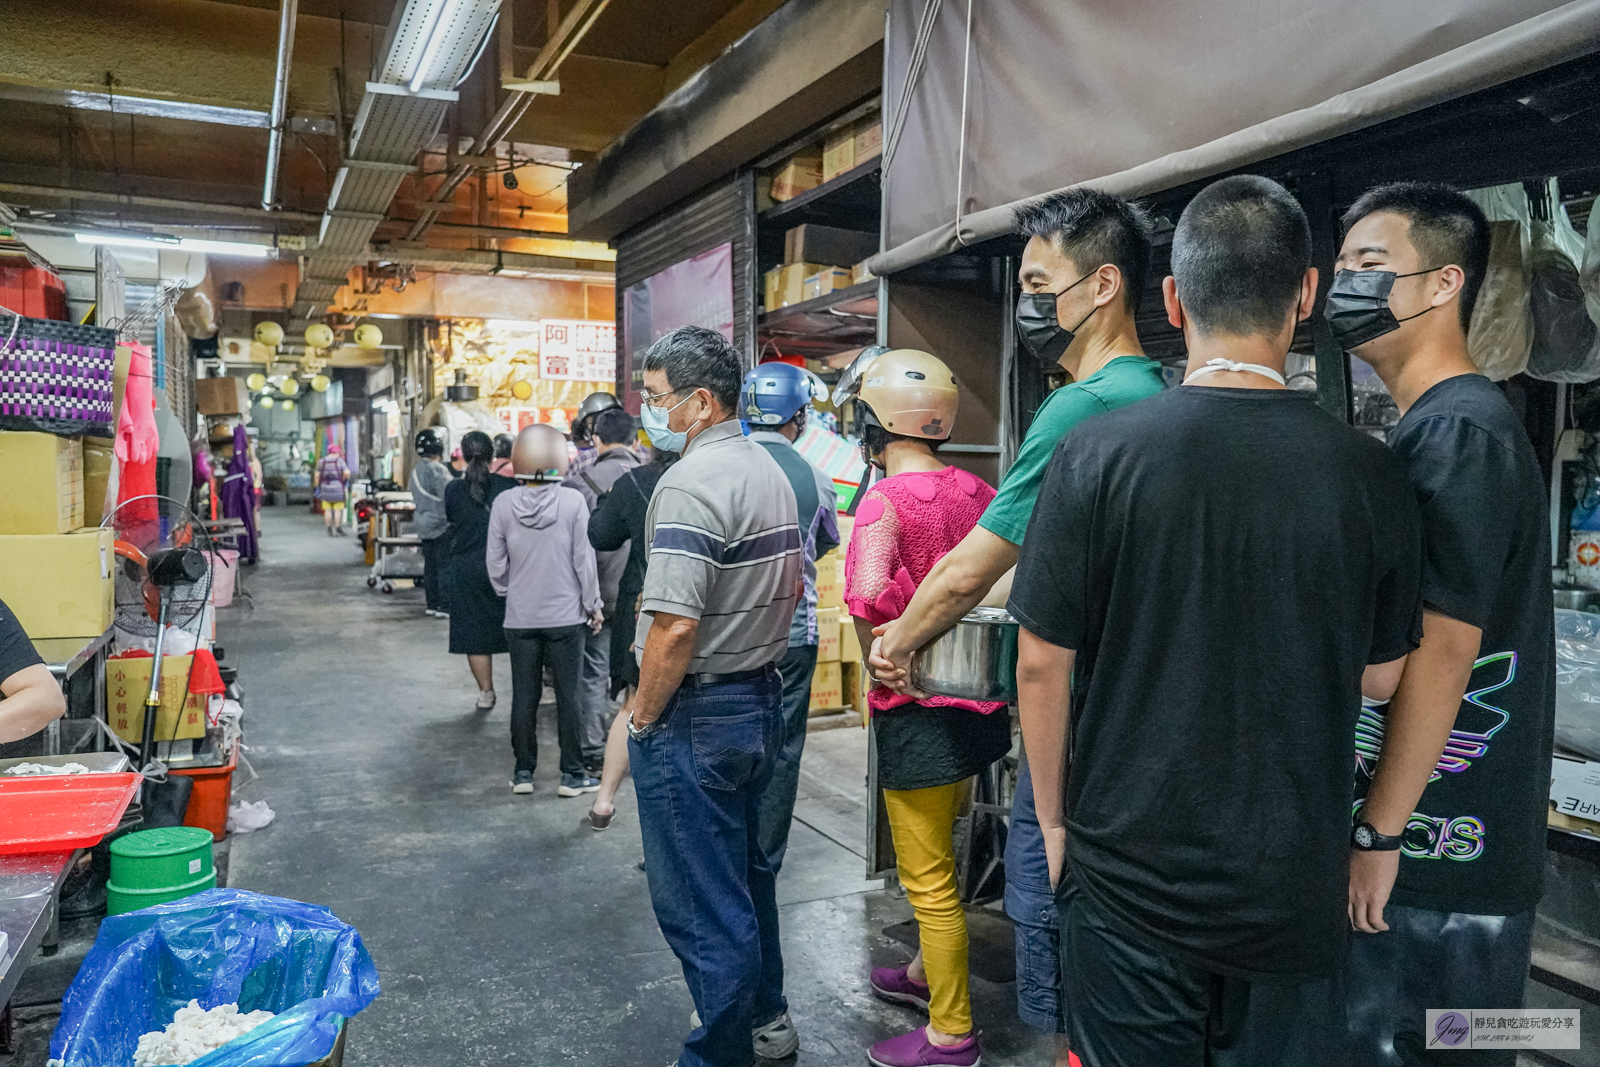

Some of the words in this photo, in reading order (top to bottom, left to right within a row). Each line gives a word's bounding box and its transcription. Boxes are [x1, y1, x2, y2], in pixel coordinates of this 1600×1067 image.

[545, 324, 569, 375] 阿富
[115, 669, 128, 730] 小心輕放
